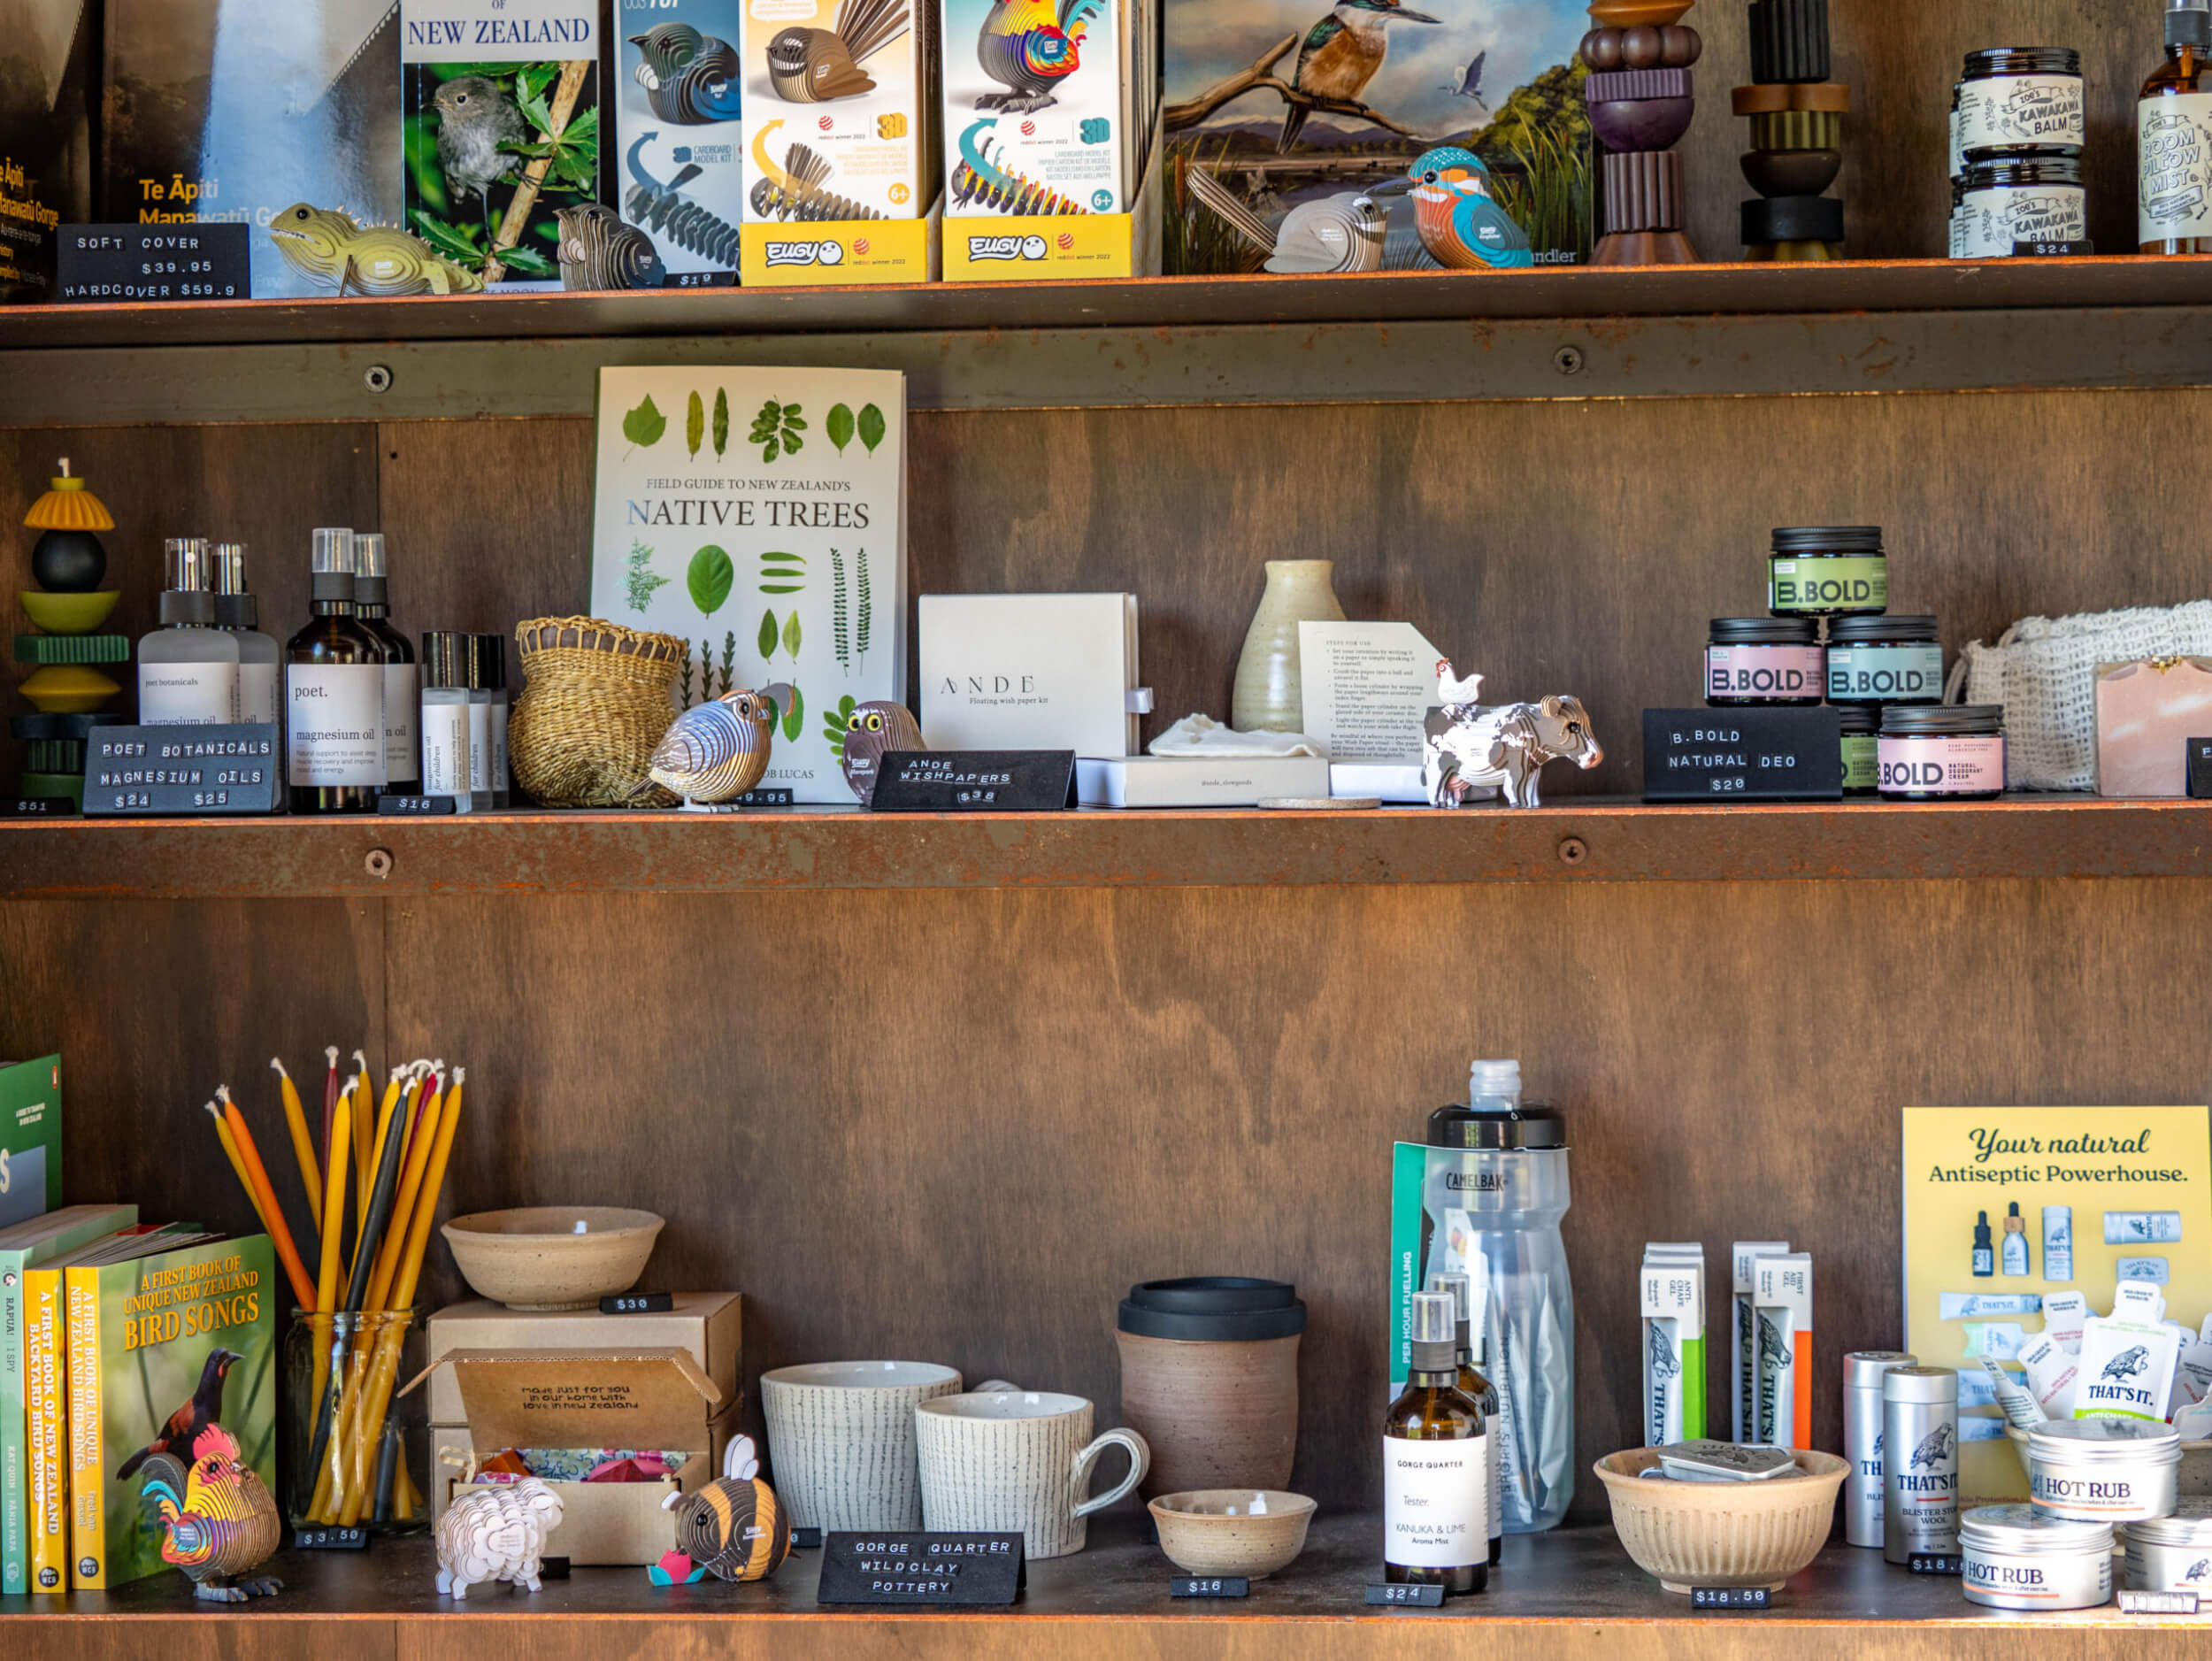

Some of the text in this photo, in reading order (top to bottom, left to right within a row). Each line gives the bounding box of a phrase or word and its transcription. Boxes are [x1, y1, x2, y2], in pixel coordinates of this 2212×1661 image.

[408, 18, 590, 45] NEW ZEALAND
[2019, 99, 2080, 123] KAWAKAWA
[877, 112, 908, 141] 3D
[1079, 117, 1110, 145] 3D
[2034, 117, 2068, 135] BALM
[2144, 127, 2196, 159] ROOM
[695, 155, 718, 164] MODEL
[139, 173, 219, 204] Te Āpiti
[2151, 168, 2190, 195] MIST
[891, 187, 907, 201] 6+
[1094, 194, 1111, 207] 6+
[35, 200, 59, 232] Gorge
[2015, 210, 2078, 235] KAWAKAWA
[2030, 227, 2064, 242] BALM
[77, 237, 199, 250] SOFT COVER
[968, 235, 1024, 263] EUGY
[2037, 243, 2069, 254] $24
[766, 241, 820, 268] EUGY
[142, 260, 212, 274] $39.95
[65, 283, 234, 298] HARDCOVER $59.9
[646, 478, 850, 492] FIELD GUIDE TO NEW ZEALAND'S
[626, 498, 870, 530] NATIVE TREES
[1777, 580, 1870, 604] B.BOLD
[159, 677, 199, 687] botanicals
[941, 675, 1034, 694] ANDE
[1712, 668, 1803, 691] B.BOLD
[1831, 670, 1924, 693] B.BOLD
[295, 684, 328, 701] poet.
[969, 696, 998, 705] Floating
[1018, 697, 1037, 706] paper
[296, 728, 375, 742] magnesium oil
[395, 725, 407, 737] oil
[1672, 729, 1740, 744] B.BOLD
[103, 742, 270, 757] POET BOTANICALS
[909, 759, 953, 770] ANDE
[1669, 755, 1796, 767] NATURAL DEO
[100, 770, 261, 785] MAGNESIUM OILS
[779, 769, 814, 780] LUCAS
[900, 771, 1010, 783] WISHPAPERS
[1712, 779, 1744, 791] $20
[115, 793, 227, 808] $24 $25
[399, 798, 430, 810] $16
[961, 790, 995, 802] $38
[1968, 1127, 2152, 1163] Your natural
[1446, 1172, 1504, 1192] CAMELBAK
[1928, 1165, 2188, 1186] Antiseptic Powerhouse.
[142, 1255, 242, 1291] A FIRST BOOK OF
[123, 1271, 259, 1315] UNIQUE NEW ZEALAND
[1402, 1251, 1412, 1364] PER HOUR FUELLING
[124, 1292, 259, 1352] BIRD SONGS
[6, 1354, 16, 1373] SPY
[71, 1286, 86, 1471] NEW ZEALAND BIRD SONGS
[83, 1292, 98, 1465] A FIRST BOOK OF UNIQUE
[1500, 1337, 1509, 1424] NUTRITION
[2089, 1385, 2135, 1401] THAT'S
[2136, 1389, 2154, 1406] IT.
[28, 1324, 44, 1503] BACKYARD BIRD SONGS
[41, 1291, 59, 1534] A FIRST BOOK OF NEW ZEALAND
[1654, 1383, 1664, 1446] THAT'S
[1762, 1375, 1775, 1437] THAT'S
[1397, 1460, 1463, 1469] GORGE QUARTER
[1897, 1474, 1948, 1491] THAT'S
[2047, 1478, 2131, 1499] HOT RUB
[1902, 1508, 1940, 1517] BLISTER
[304, 1529, 359, 1544] $3.50
[1436, 1525, 1443, 1534] &
[1447, 1523, 1466, 1534] LIME
[855, 1541, 1010, 1555] GORGE QUARTER
[861, 1560, 958, 1574] WILDCLAY
[1968, 1560, 2044, 1585] HOT RUB
[872, 1580, 950, 1594] POTTERY
[1188, 1579, 1222, 1594] $16
[1386, 1587, 1419, 1600] $24
[1696, 1590, 1765, 1603] $18.50
